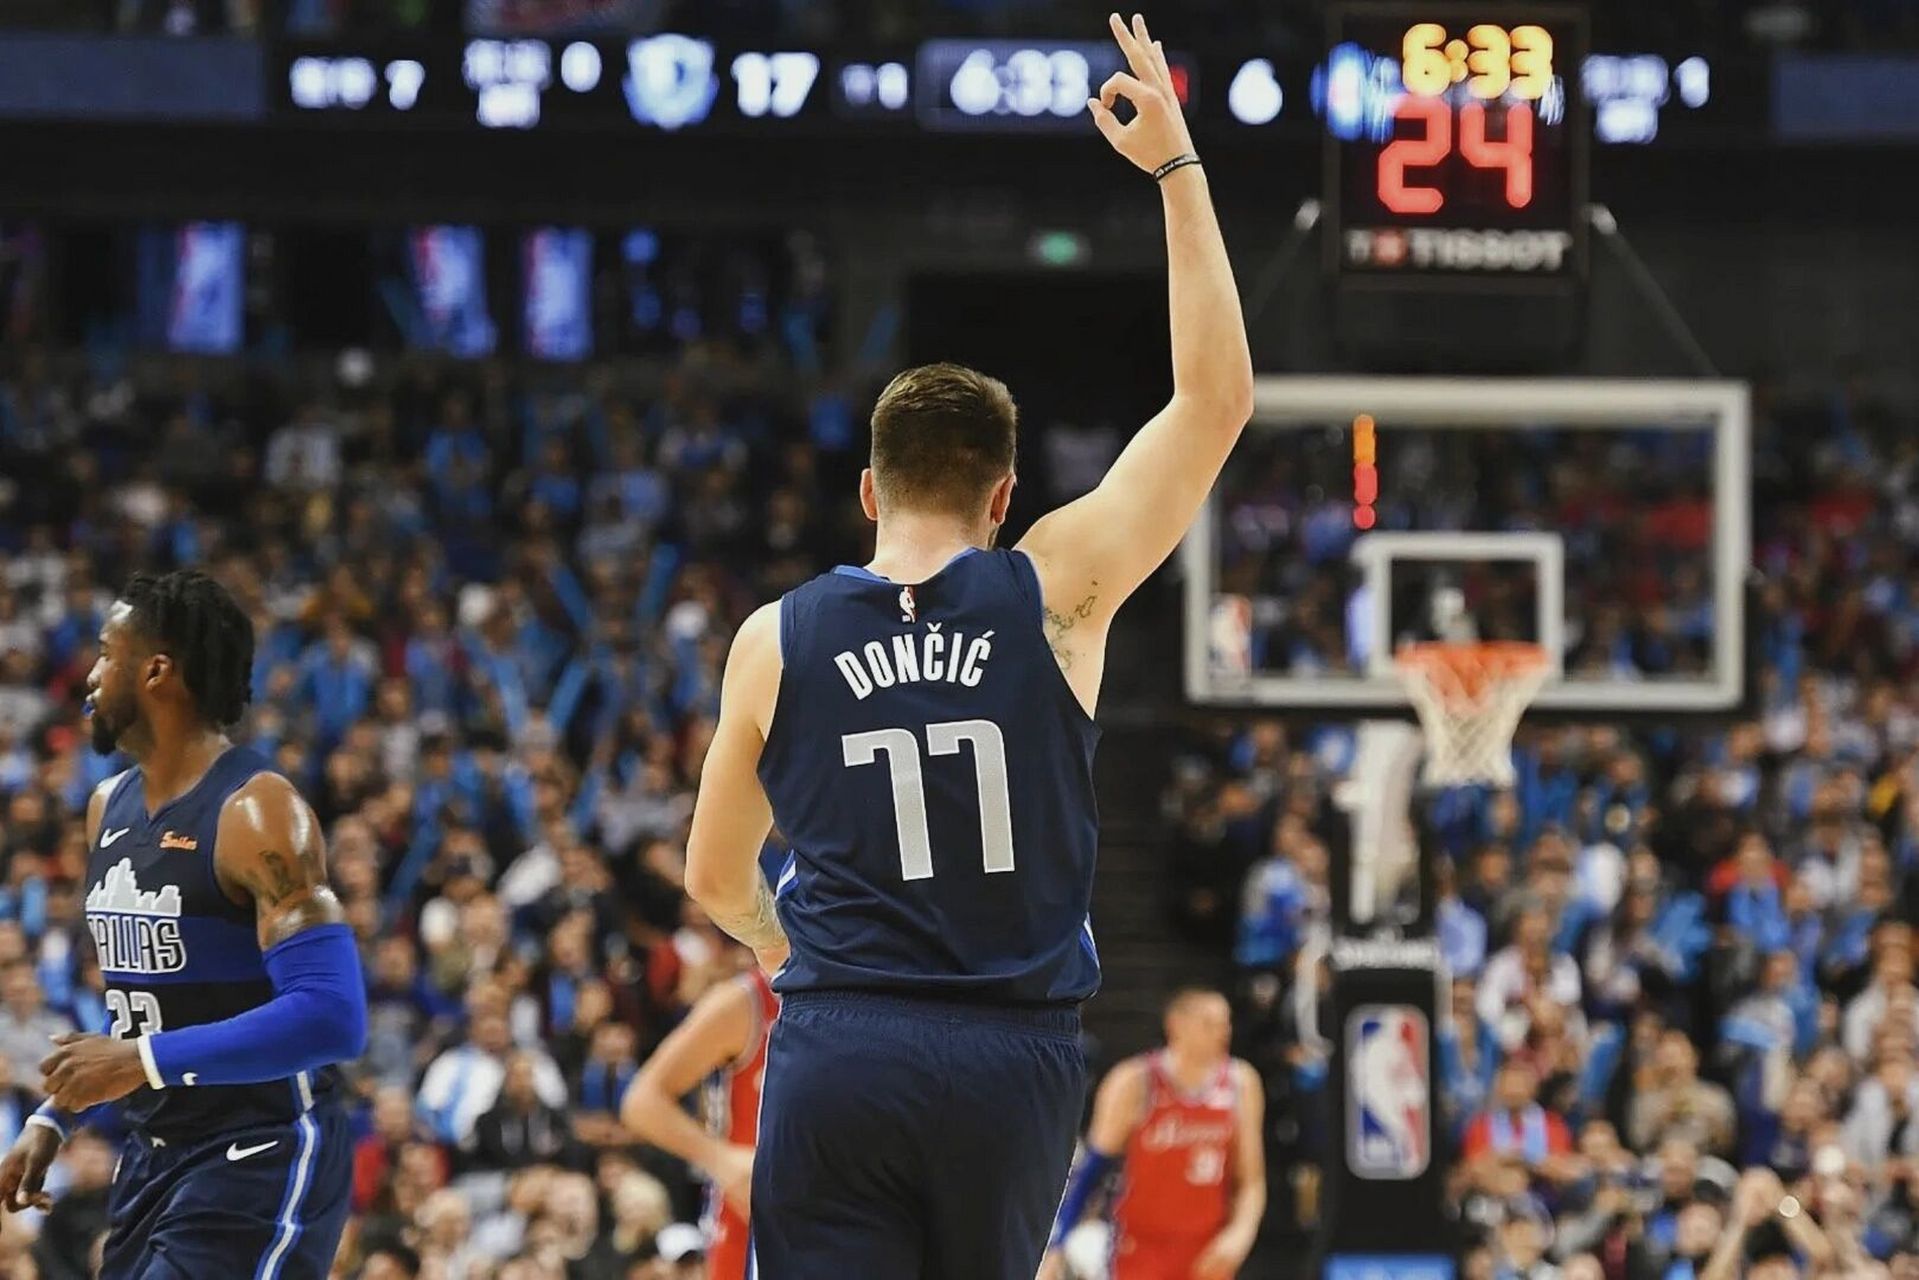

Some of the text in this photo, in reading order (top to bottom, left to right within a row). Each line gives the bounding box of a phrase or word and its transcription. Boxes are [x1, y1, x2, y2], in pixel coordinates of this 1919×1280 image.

[1403, 23, 1553, 99] 6:33
[1377, 95, 1533, 214] 24
[834, 622, 995, 700] DONČIĆ
[841, 719, 1015, 881] 77
